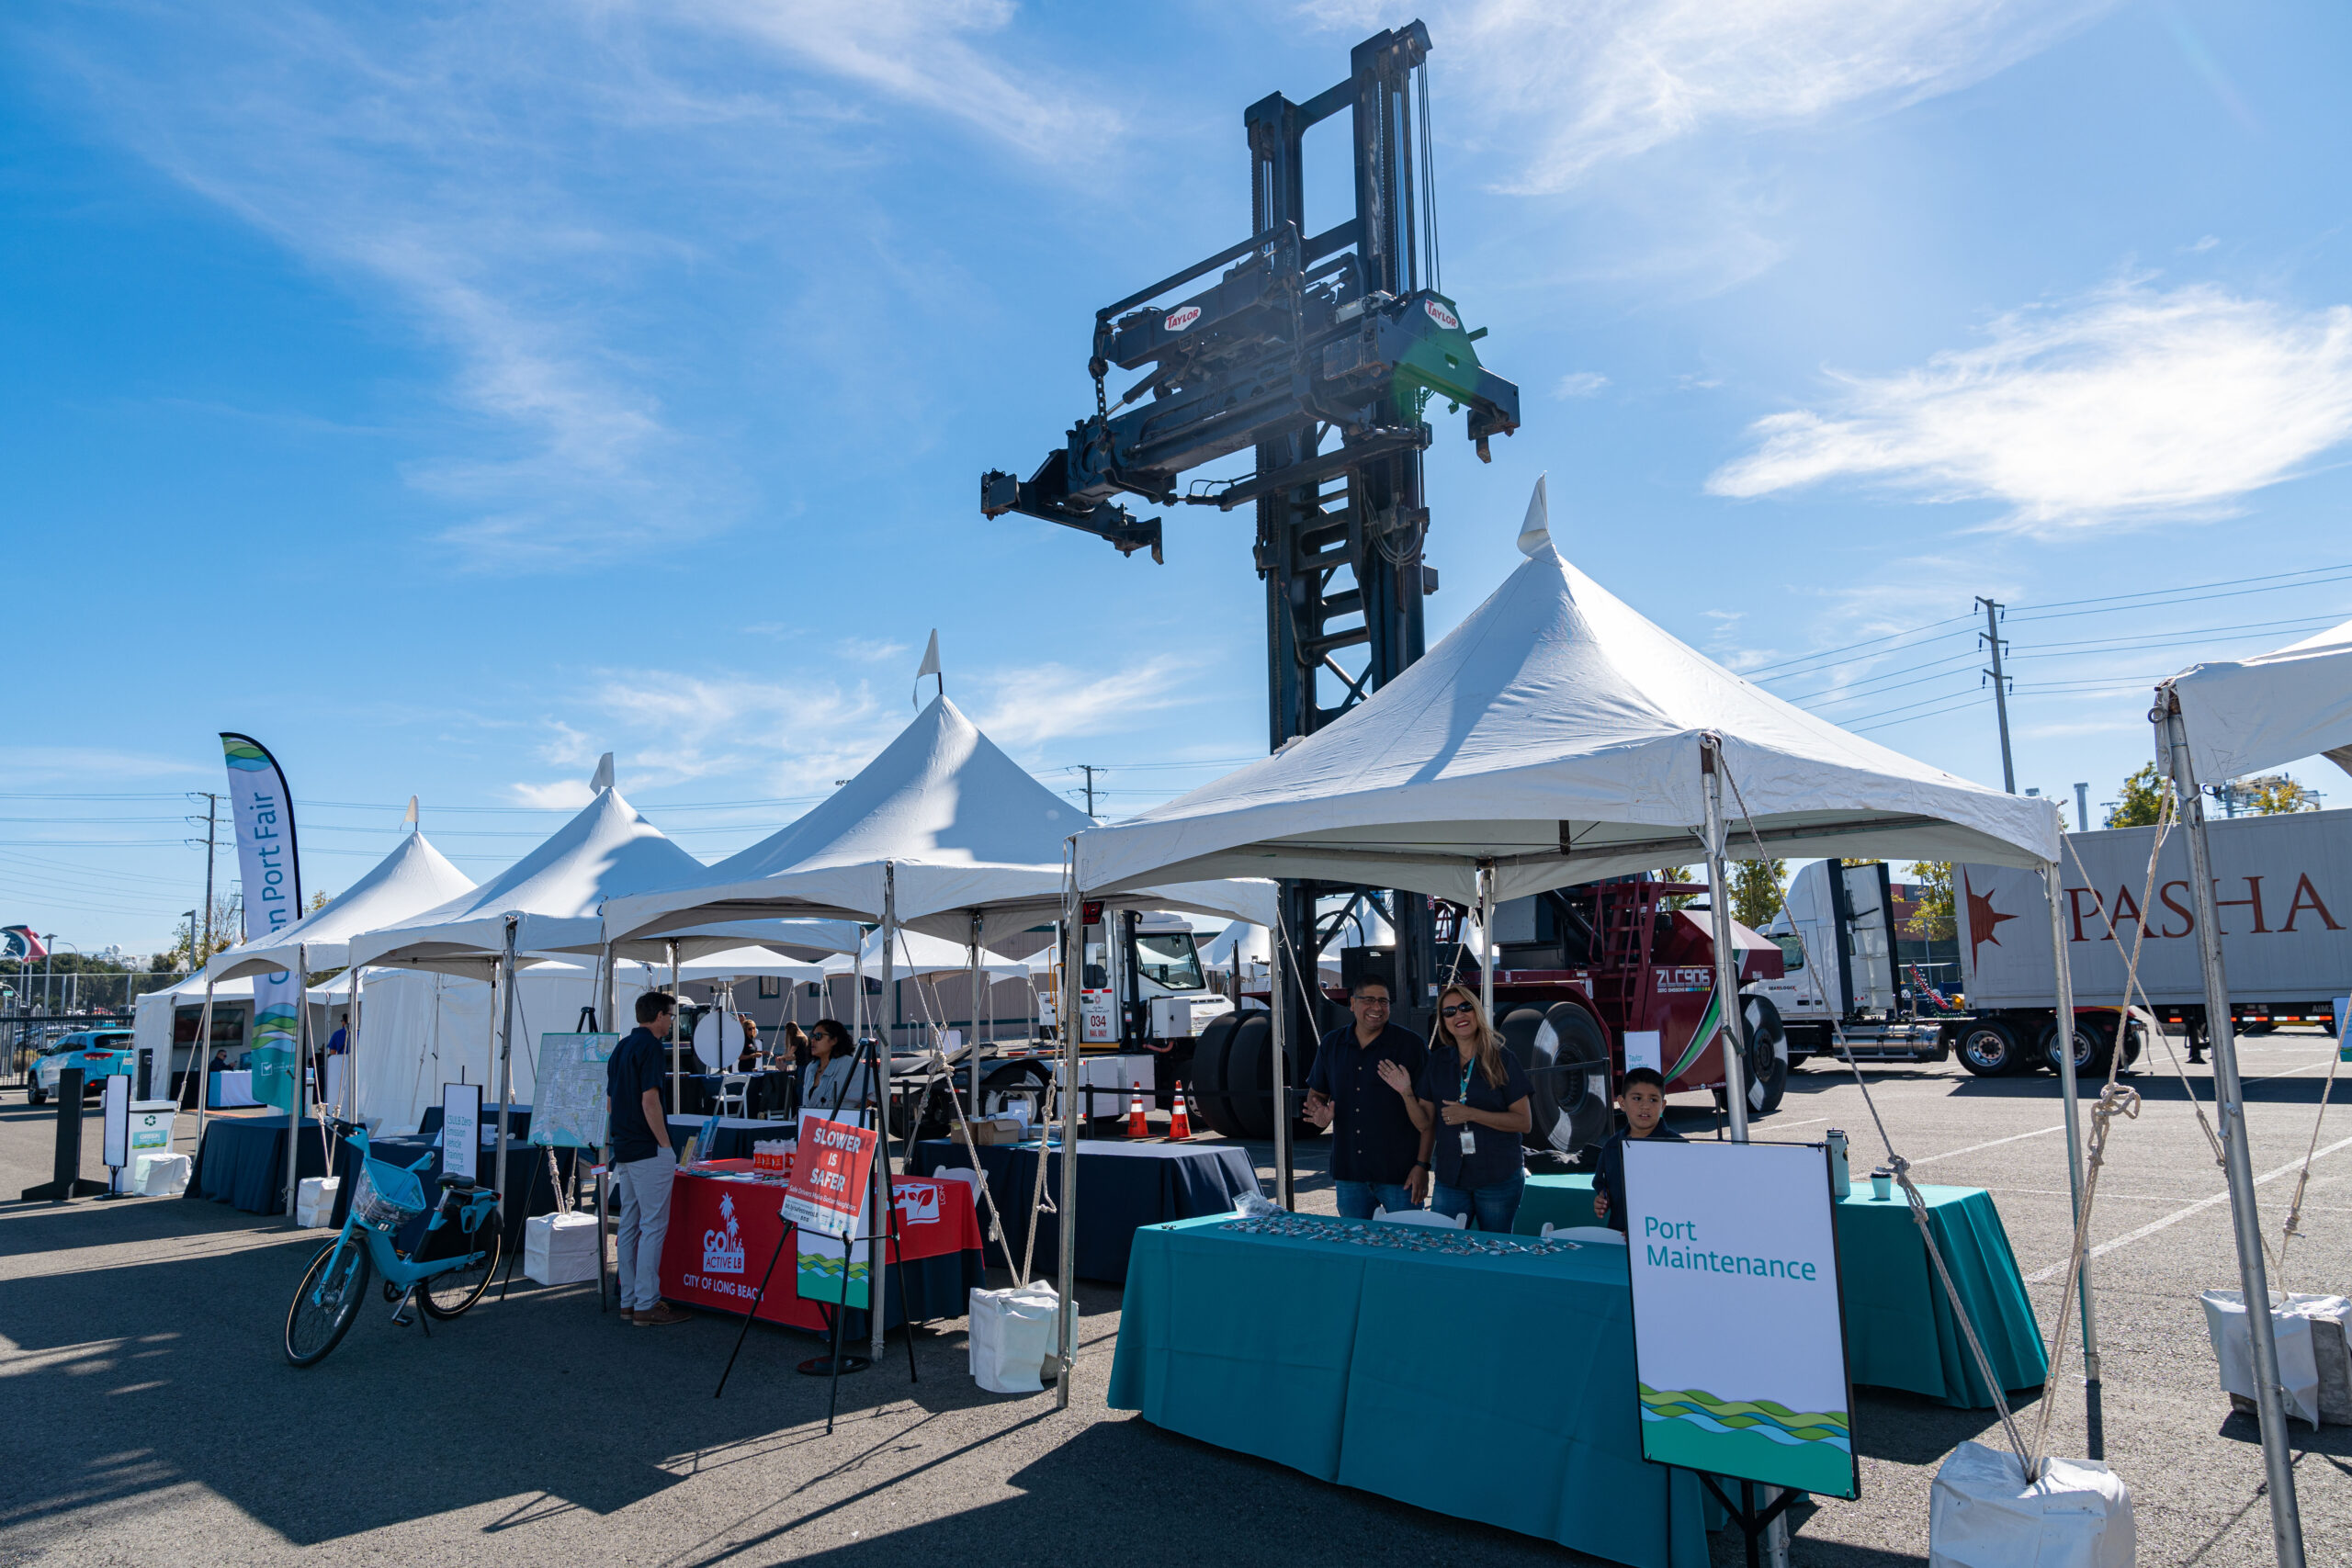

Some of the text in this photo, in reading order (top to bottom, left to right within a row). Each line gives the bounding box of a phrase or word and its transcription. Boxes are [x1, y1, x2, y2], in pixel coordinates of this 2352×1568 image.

[1166, 308, 1199, 330] TAYLOR
[1425, 299, 1457, 328] TAYLOR
[249, 792, 279, 840] Fair
[262, 844, 286, 902] Port
[2064, 872, 2347, 942] PASHA
[1091, 1015, 1106, 1027] 034
[813, 1127, 862, 1154] SLOWER
[828, 1152, 838, 1167] IS
[809, 1168, 846, 1192] SAFER
[788, 1185, 797, 1193] Safe
[797, 1188, 812, 1197] Drivers
[812, 1191, 823, 1201] Make
[822, 1195, 836, 1204] Better
[703, 1229, 727, 1252] GO
[1645, 1216, 1698, 1242] Port
[706, 1257, 742, 1269] ACTIVE LB
[1646, 1244, 1816, 1281] Maintenance
[683, 1273, 699, 1288] CITY
[701, 1277, 712, 1290] OF
[713, 1280, 736, 1296] LONG
